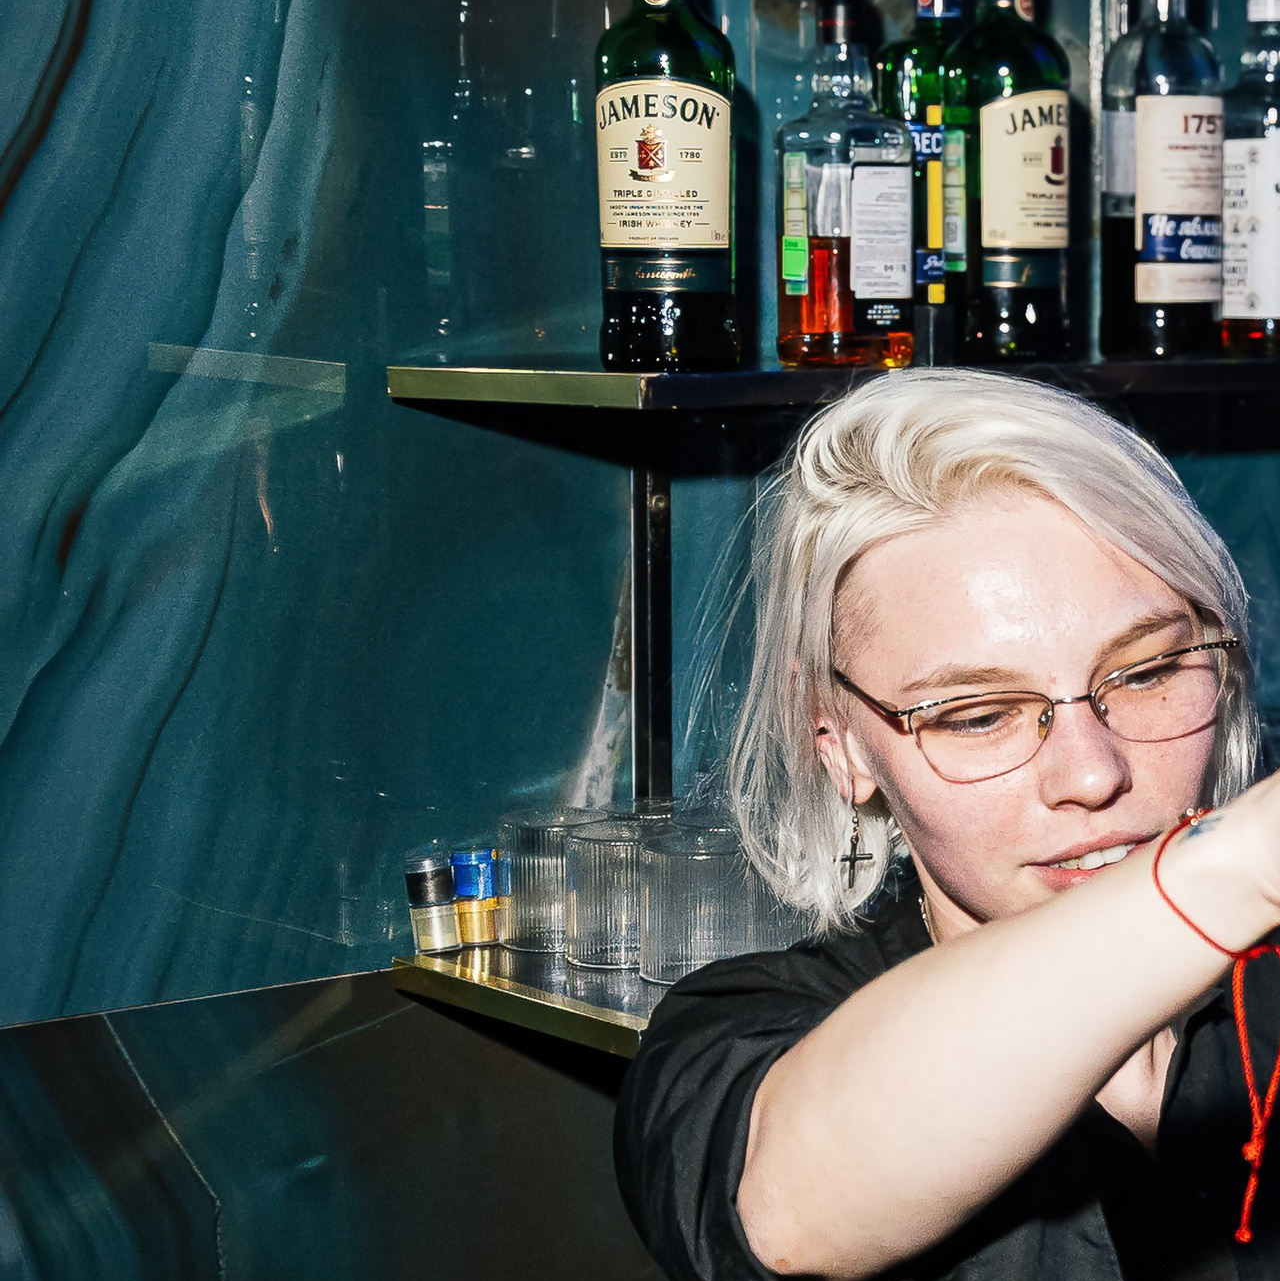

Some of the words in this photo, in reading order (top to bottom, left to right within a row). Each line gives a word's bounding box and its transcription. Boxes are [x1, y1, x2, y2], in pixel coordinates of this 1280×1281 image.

[599, 94, 717, 130] JAMESON
[613, 190, 643, 198] TRIPLE
[619, 220, 642, 228] IRISH
